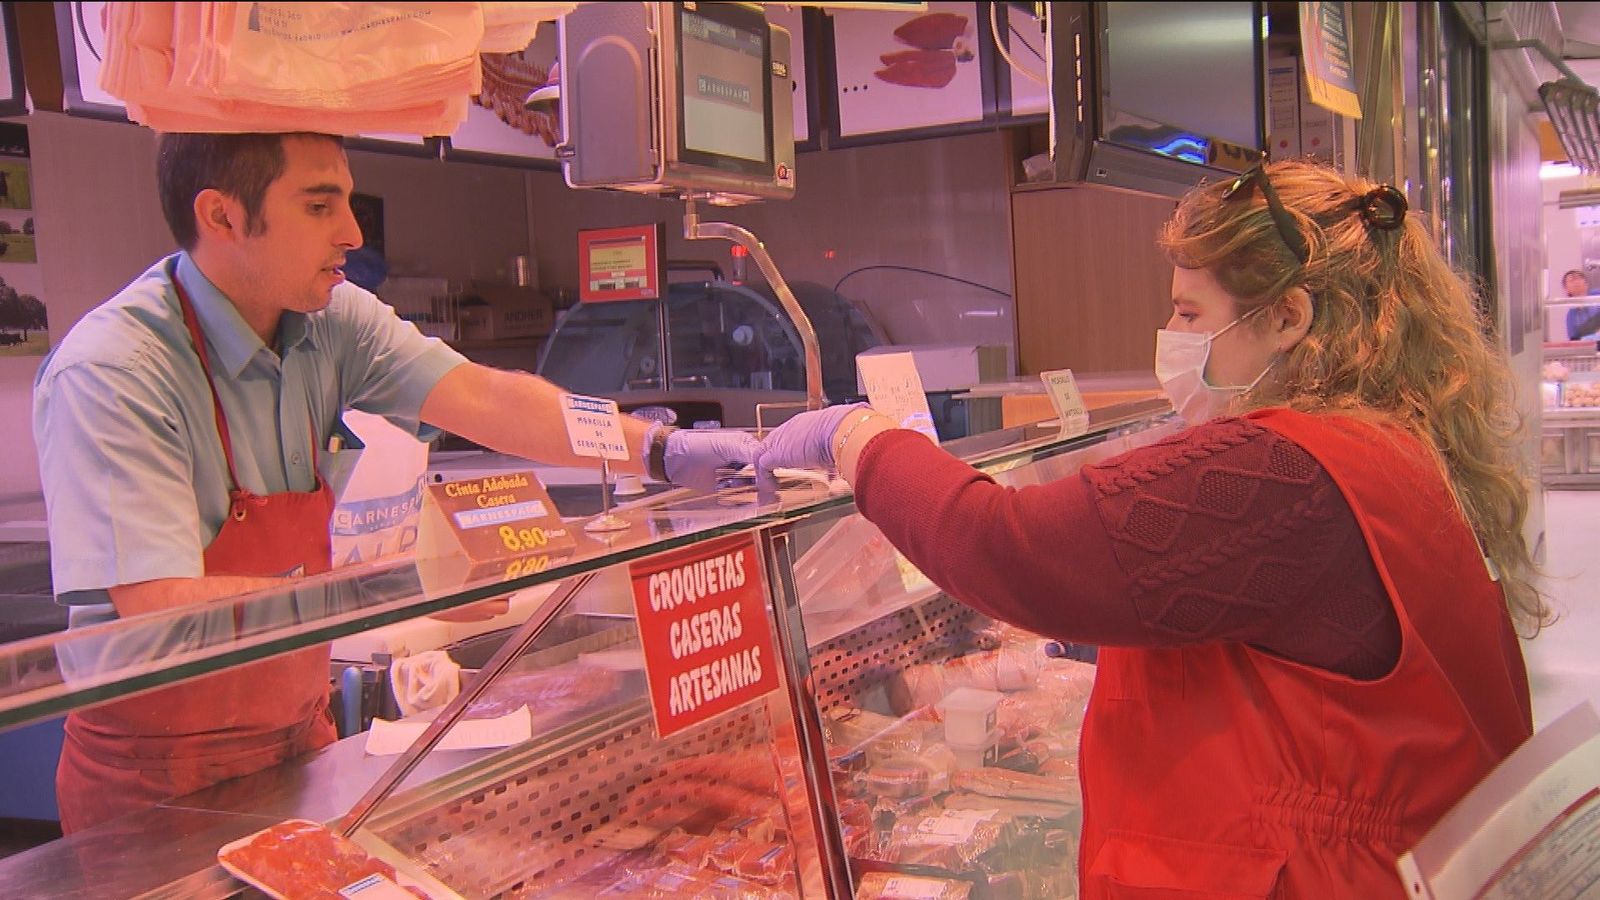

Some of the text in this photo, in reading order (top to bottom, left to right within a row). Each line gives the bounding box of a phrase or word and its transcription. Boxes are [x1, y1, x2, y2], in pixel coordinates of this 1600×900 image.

[445, 473, 529, 498] Cinta Adobada
[476, 493, 517, 509] Casera
[649, 550, 746, 613] CROQUETAS
[669, 601, 743, 661] CASERAS
[669, 645, 763, 717] ARTESANAS
